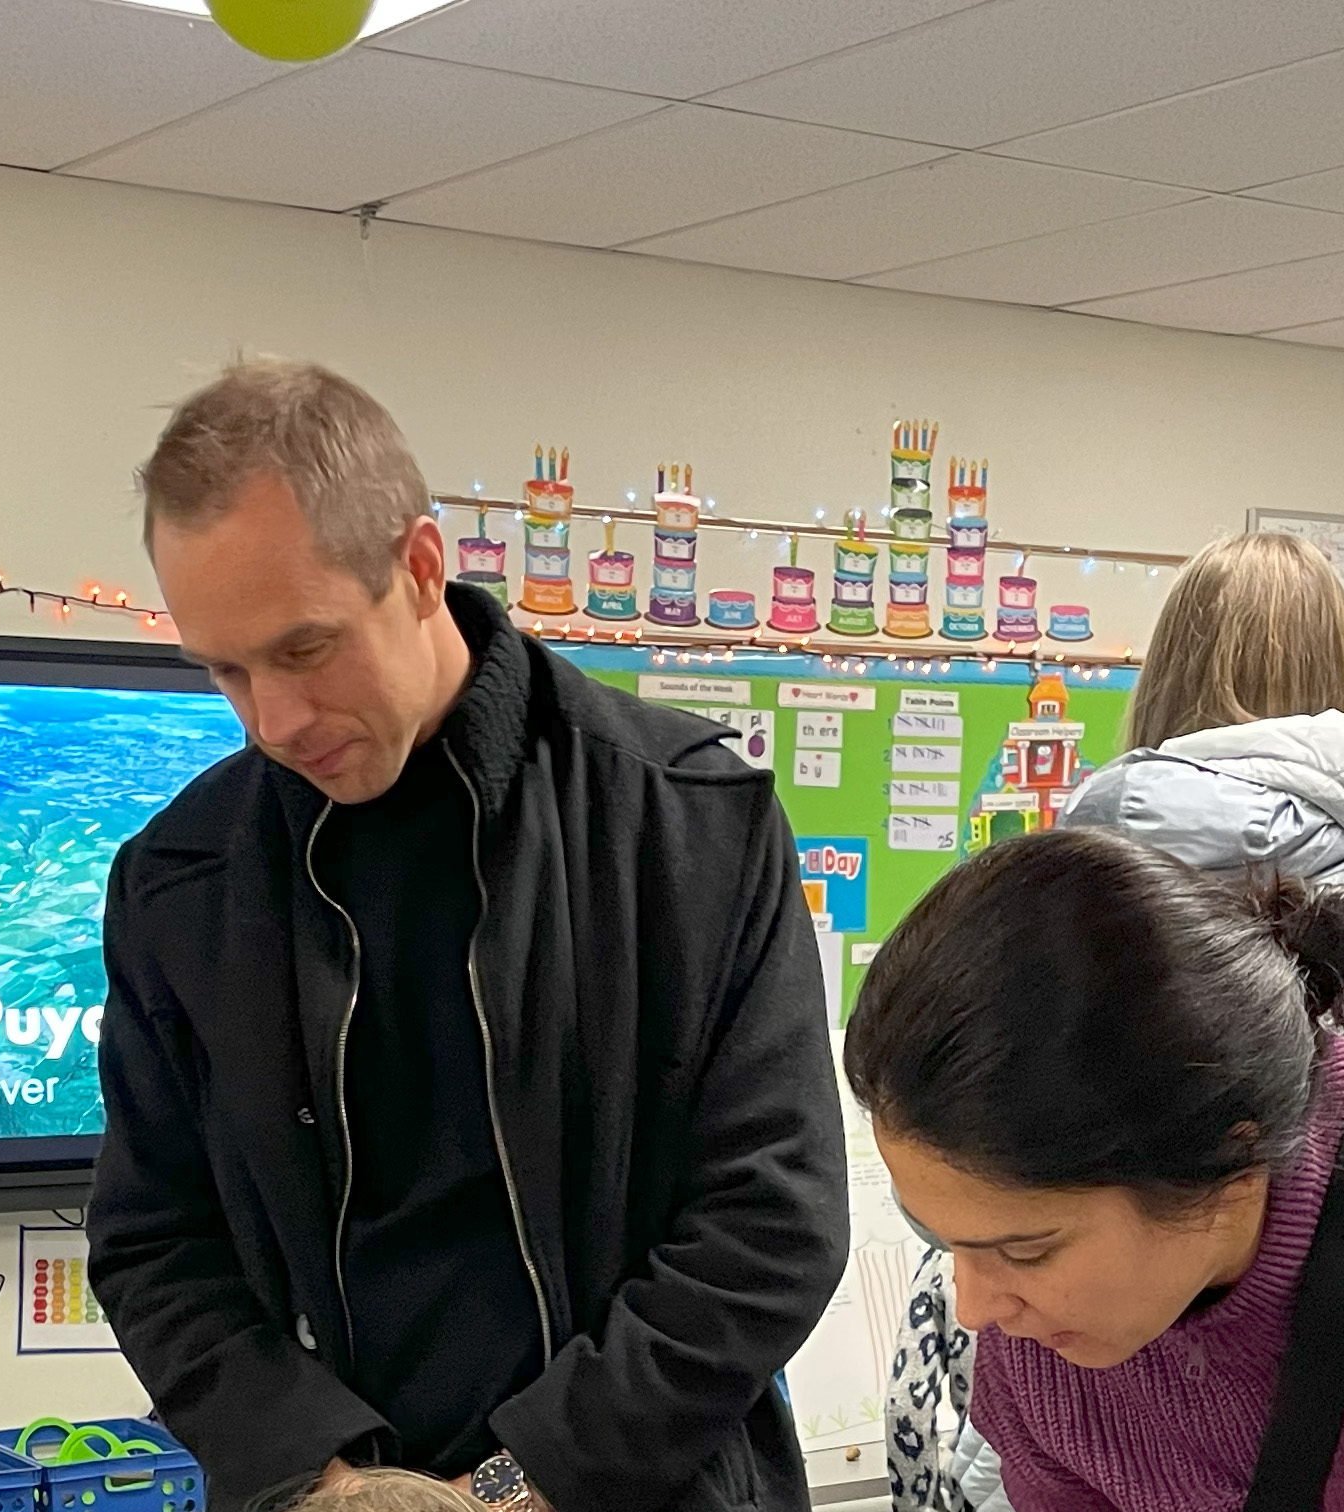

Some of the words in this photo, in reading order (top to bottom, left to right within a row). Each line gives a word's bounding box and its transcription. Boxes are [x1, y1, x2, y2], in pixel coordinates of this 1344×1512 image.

[1009, 726, 1050, 738] Classroom
[1052, 726, 1083, 739] Helpers
[937, 832, 954, 849] 25
[823, 848, 861, 878] Day
